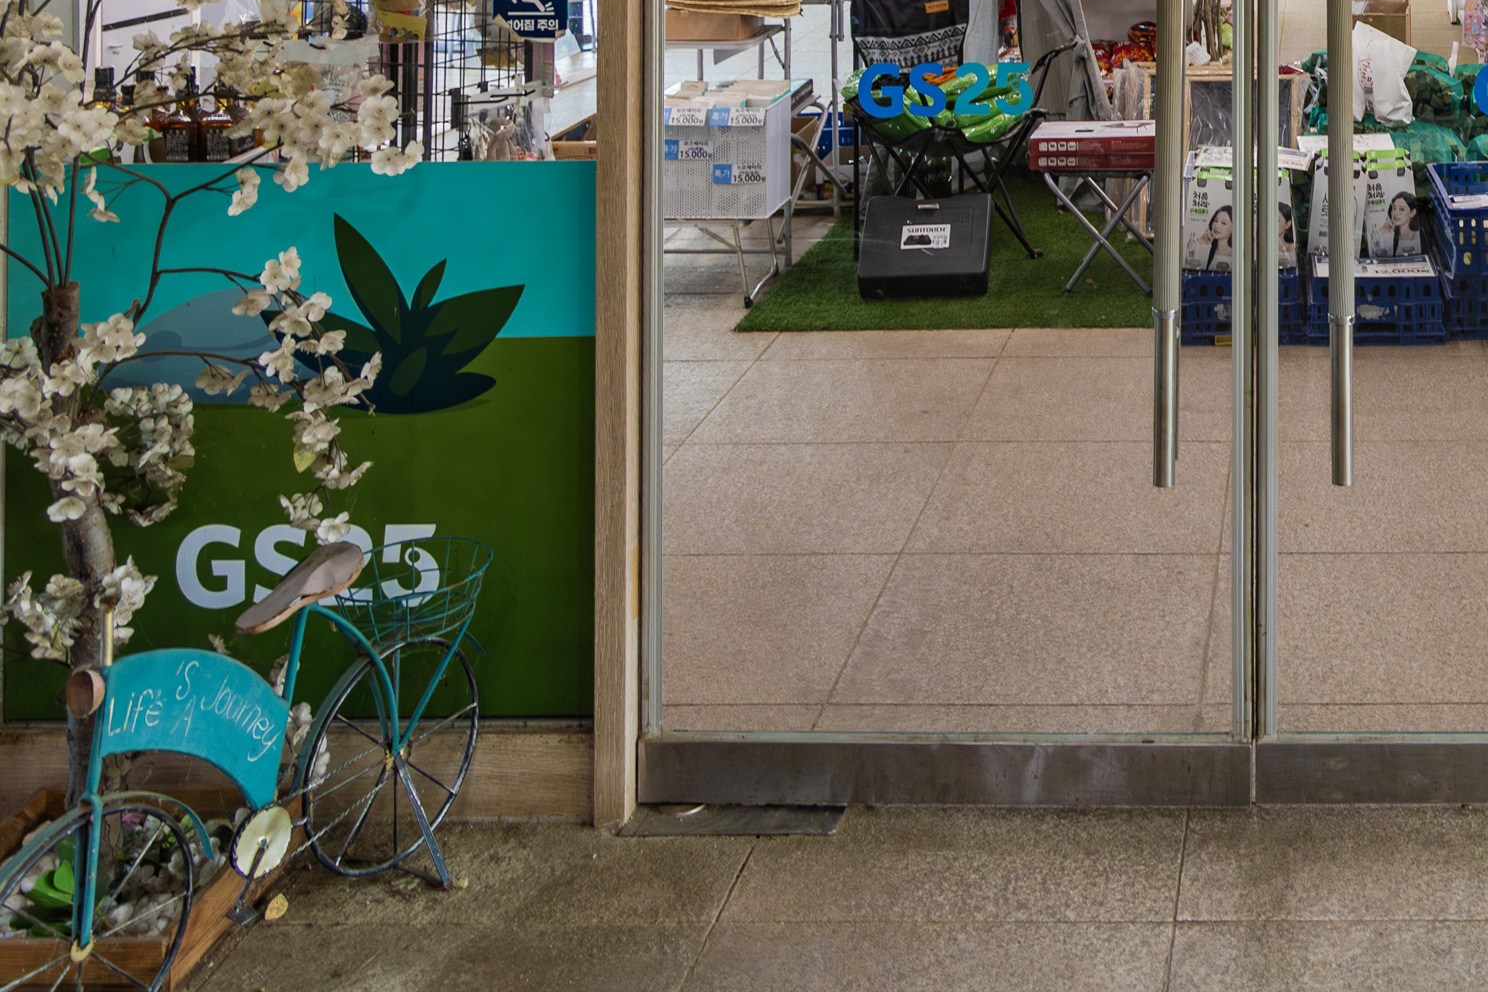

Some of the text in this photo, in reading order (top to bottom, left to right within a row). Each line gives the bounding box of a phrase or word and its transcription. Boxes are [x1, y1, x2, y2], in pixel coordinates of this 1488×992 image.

[537, 18, 559, 31] 주의
[857, 61, 1034, 118] GS25
[714, 169, 731, 179] 특가
[200, 674, 282, 762] Journey
